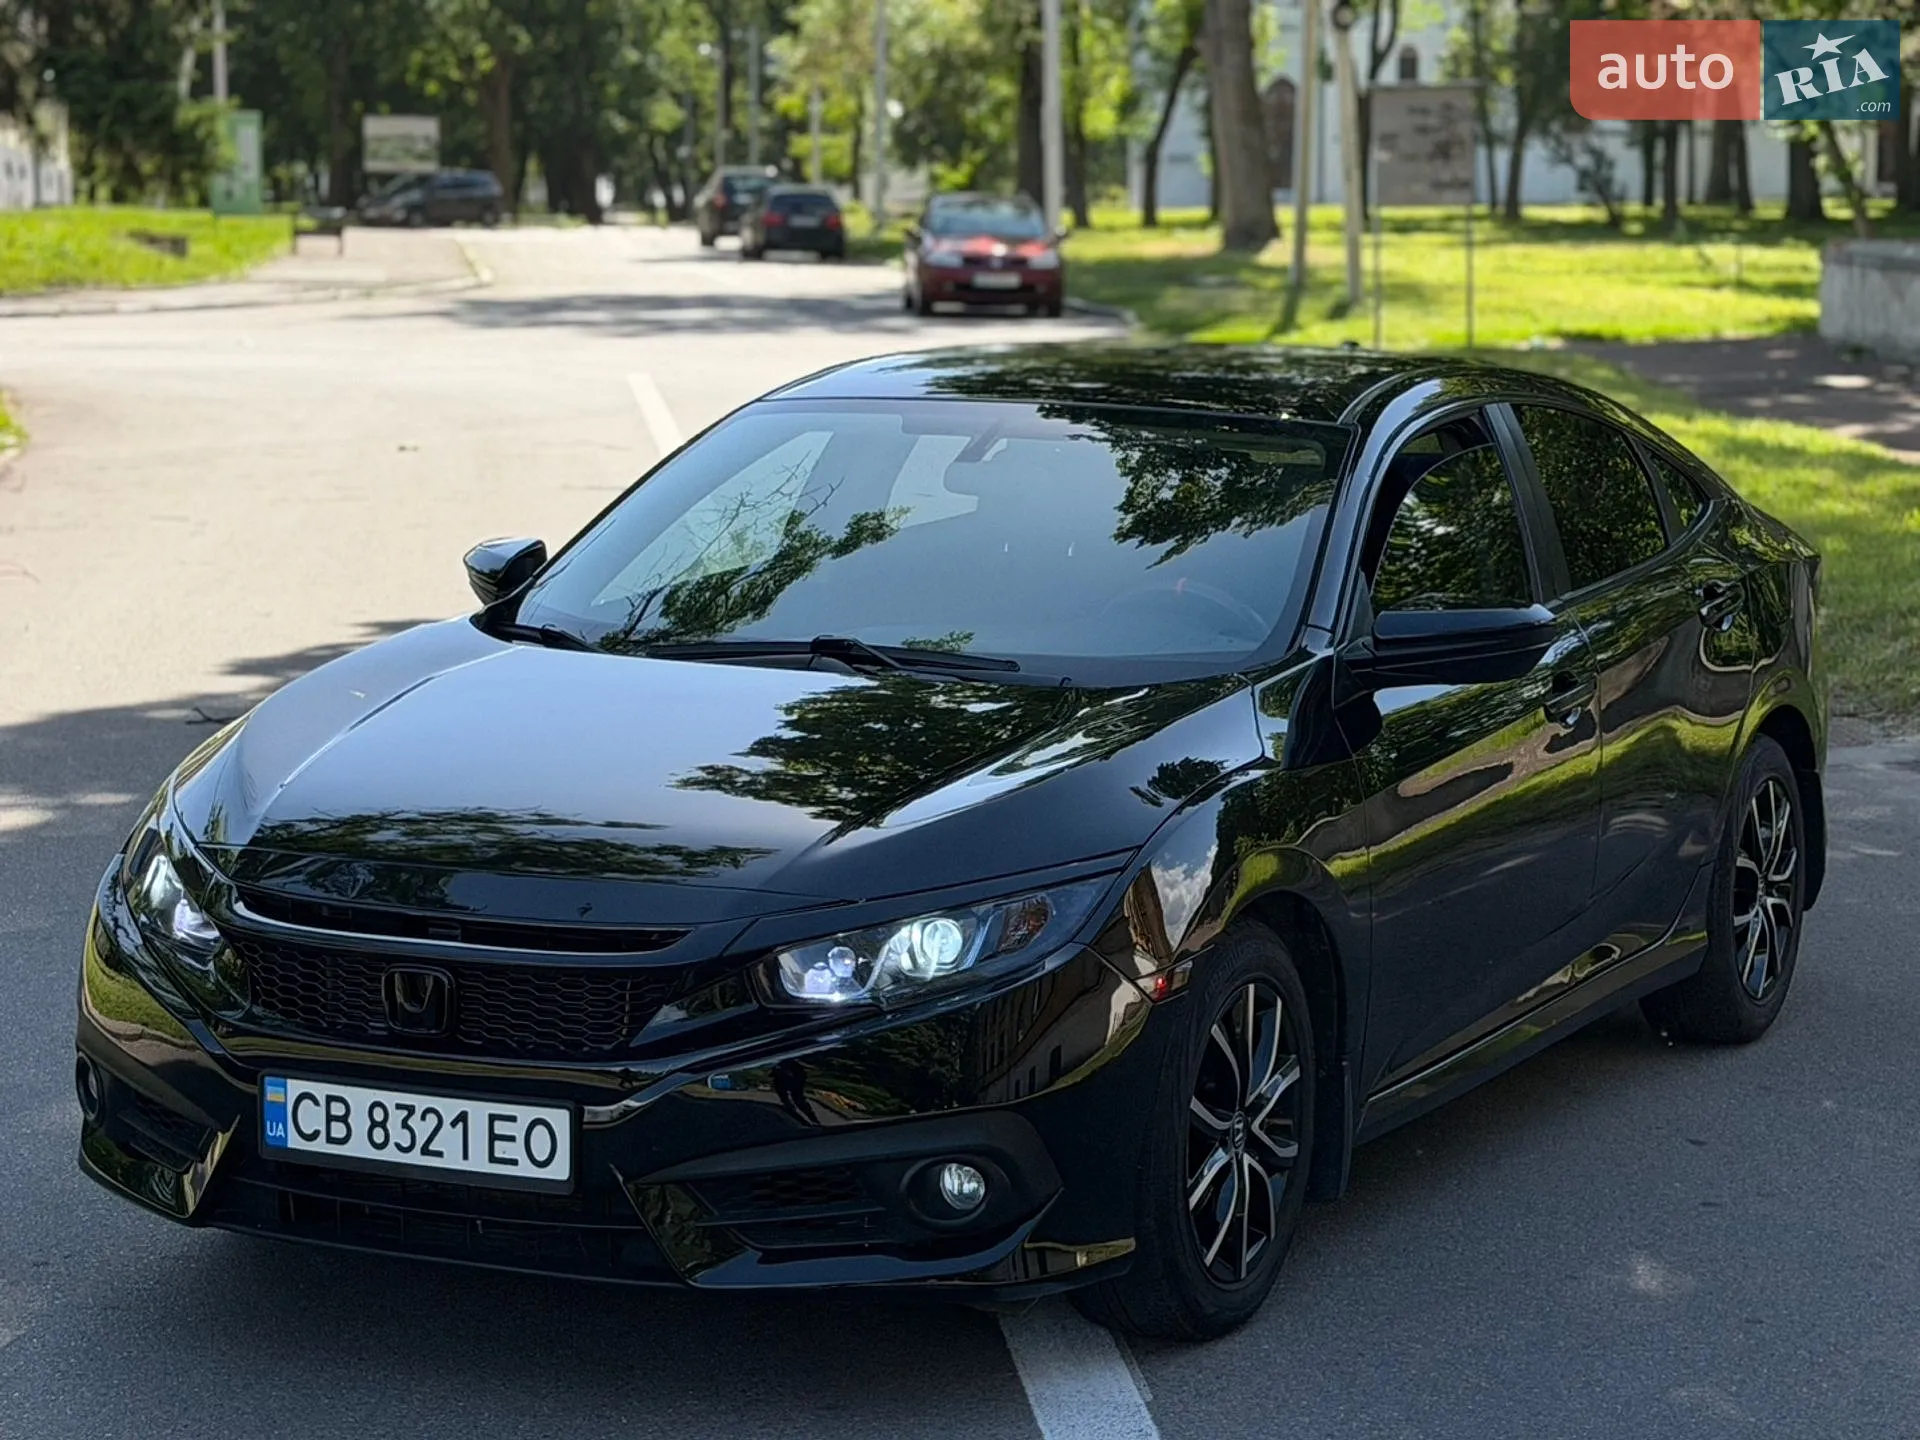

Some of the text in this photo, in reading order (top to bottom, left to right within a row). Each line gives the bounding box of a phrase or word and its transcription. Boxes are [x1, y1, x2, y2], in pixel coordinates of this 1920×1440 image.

[266, 1120, 285, 1138] UA
[291, 1091, 558, 1169] CB 8321 EO
